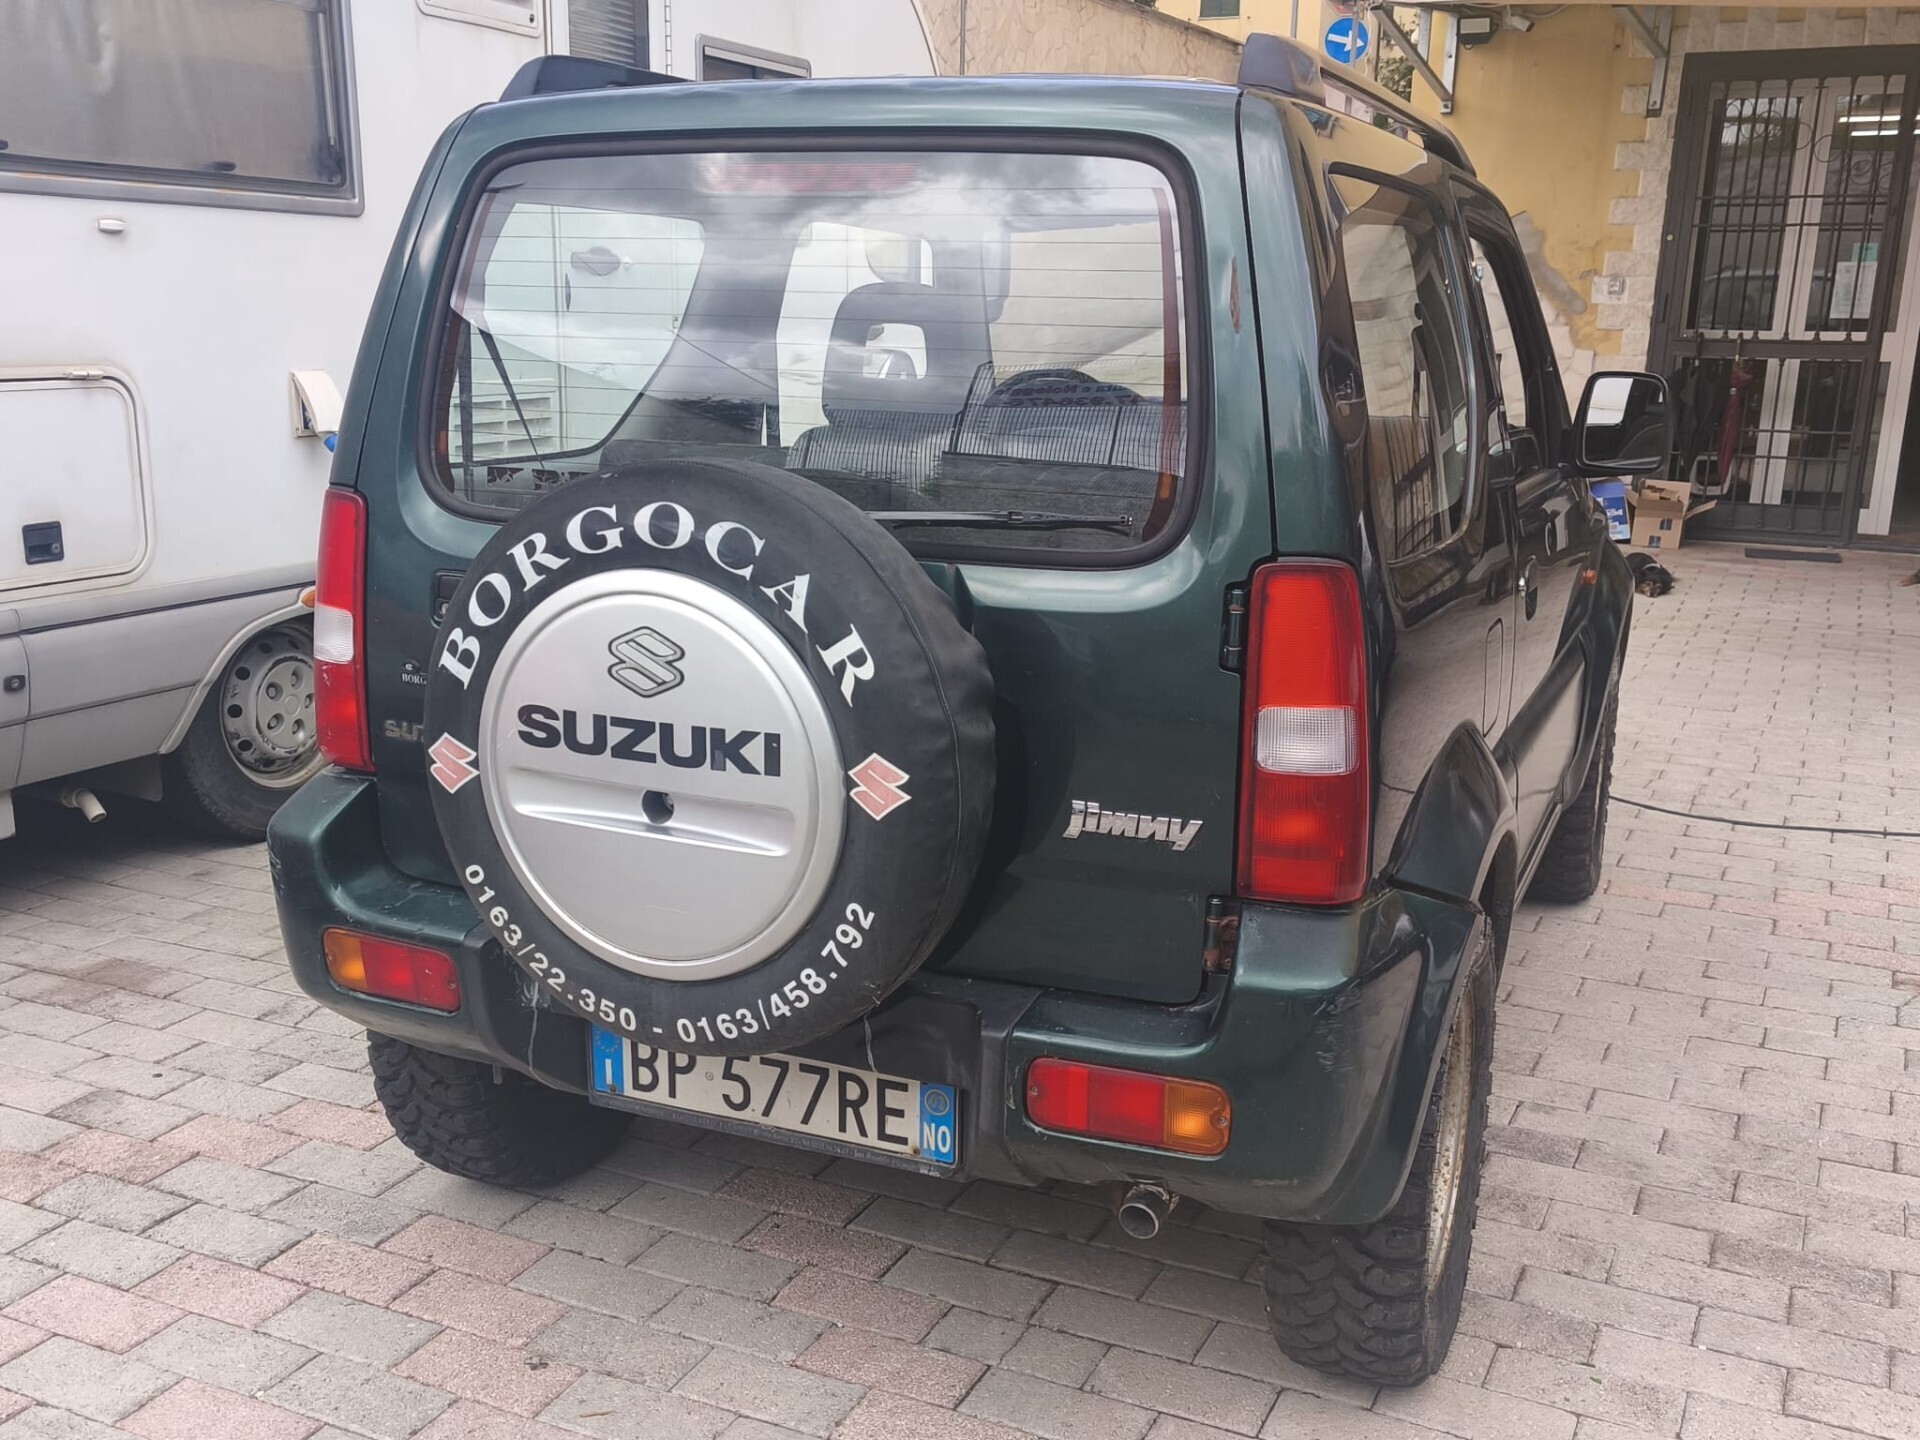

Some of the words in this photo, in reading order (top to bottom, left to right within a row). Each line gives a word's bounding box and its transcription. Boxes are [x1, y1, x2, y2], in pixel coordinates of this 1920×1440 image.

[438, 501, 876, 707] BORGOCAR
[517, 704, 782, 777] SUZUKI
[464, 864, 637, 1032] 0163/22.350
[677, 901, 876, 1044] 0163/458.792
[630, 1040, 697, 1099] BP
[721, 1055, 910, 1147] 577RE
[923, 1121, 951, 1154] NO
